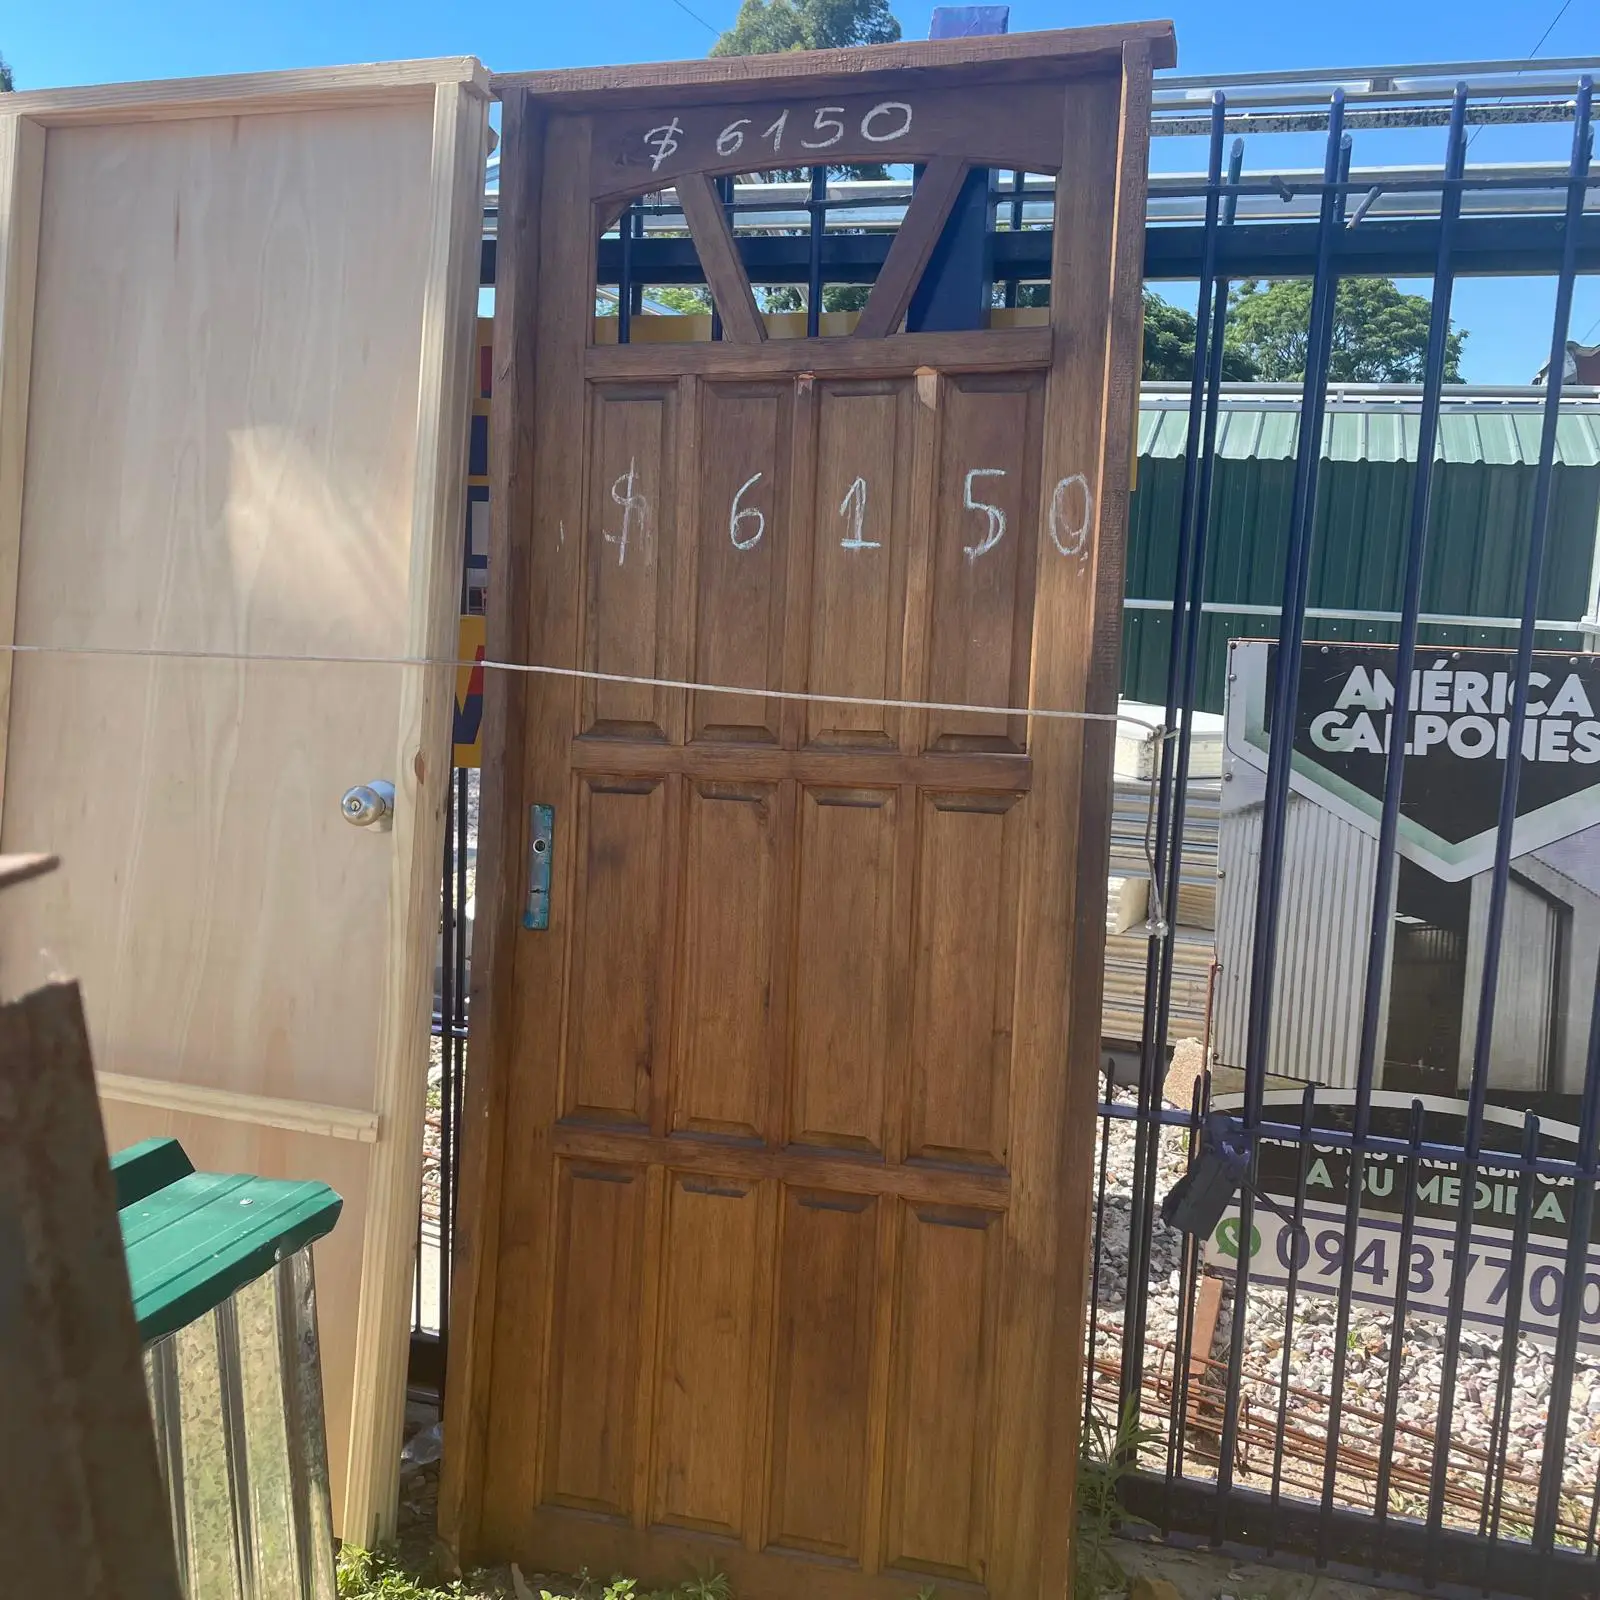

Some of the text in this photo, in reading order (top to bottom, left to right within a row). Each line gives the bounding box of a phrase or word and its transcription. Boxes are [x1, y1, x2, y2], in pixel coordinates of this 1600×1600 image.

[715, 101, 913, 156] 6150
[1333, 659, 1595, 718] AMÉRICA
[1305, 1157, 1334, 1189] A
